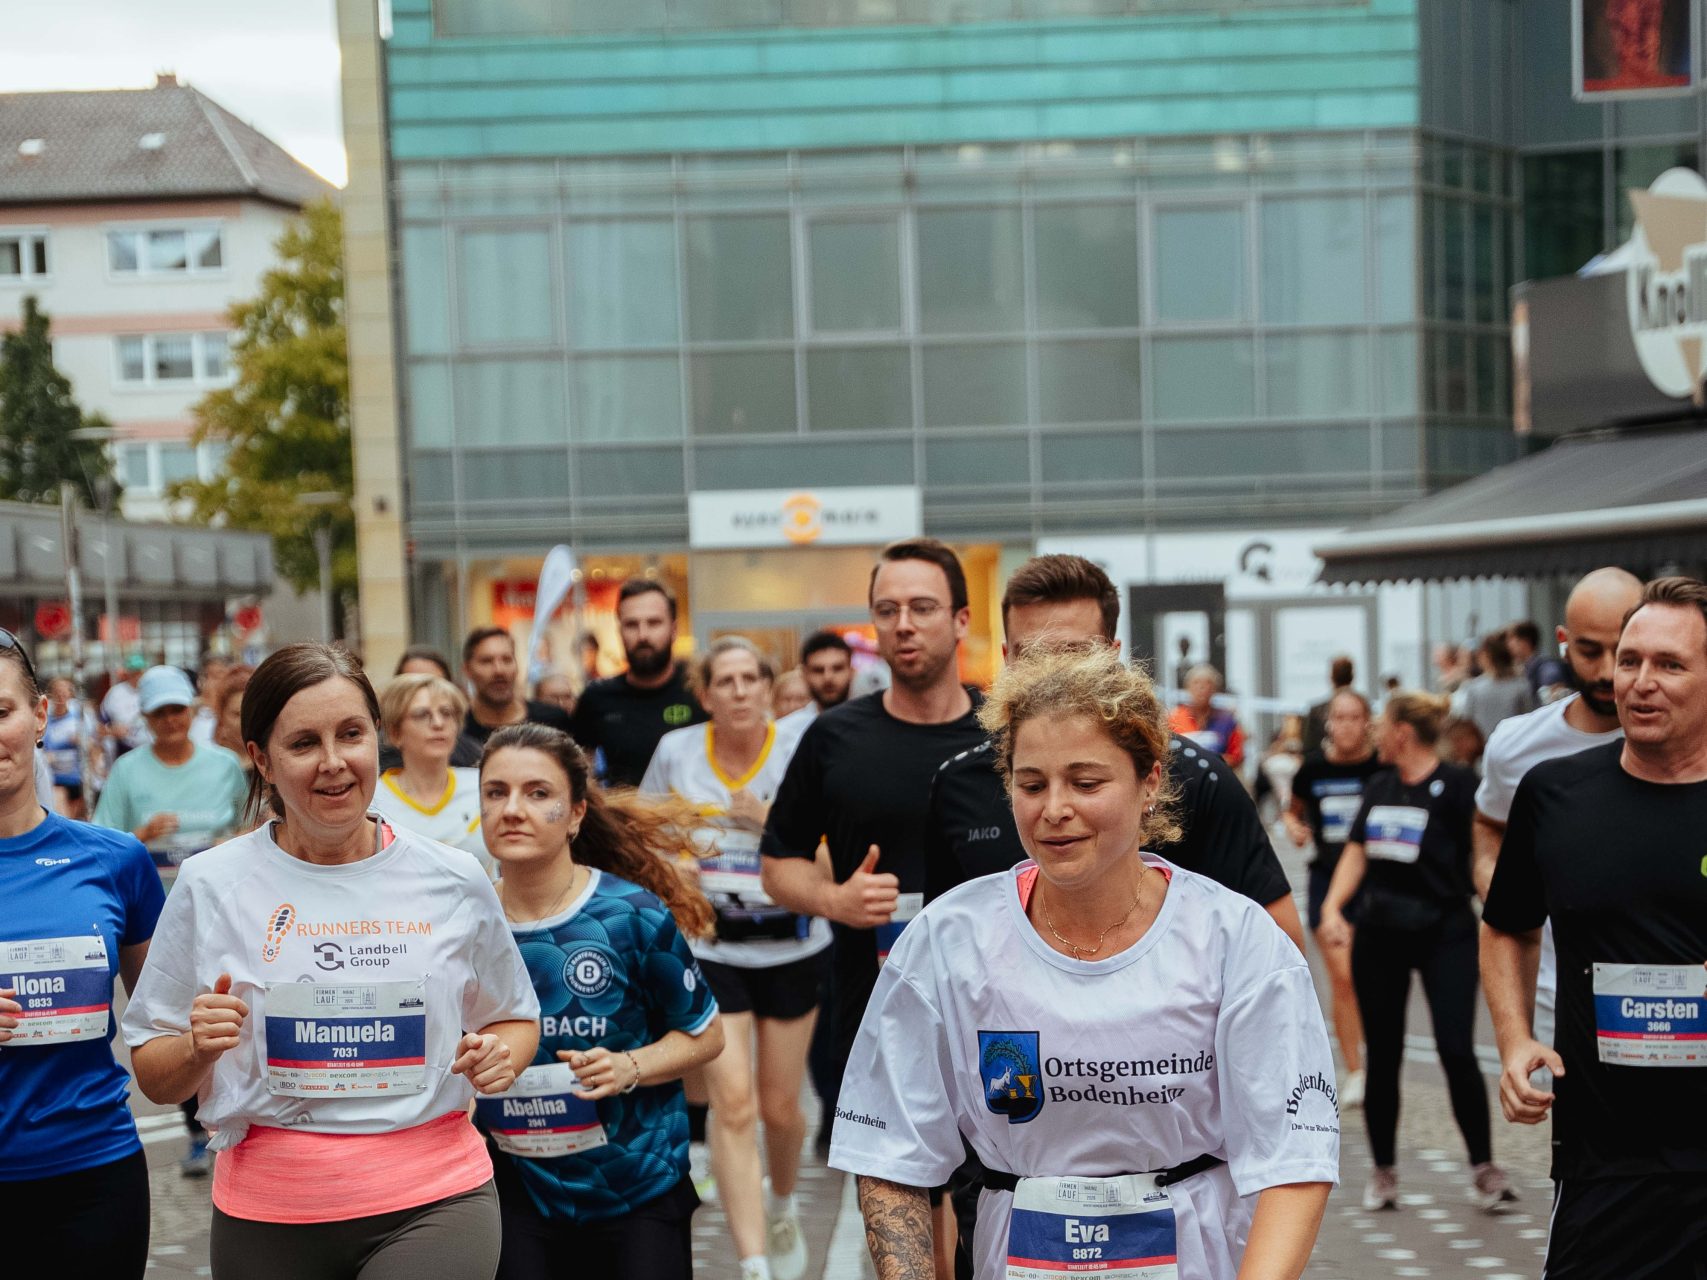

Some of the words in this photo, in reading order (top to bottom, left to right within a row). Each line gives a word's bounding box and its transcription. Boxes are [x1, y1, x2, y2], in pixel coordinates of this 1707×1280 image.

[968, 826, 1001, 841] JAKO
[296, 921, 382, 937] RUNNERS
[384, 920, 432, 936] TEAM
[349, 944, 407, 956] Landbell
[350, 957, 390, 968] Group
[583, 965, 595, 979] B
[12, 974, 66, 996] Ilona
[28, 997, 53, 1009] 8833
[315, 995, 336, 1004] LAUF
[1621, 997, 1699, 1019] Carsten
[295, 1020, 395, 1043] Manuela
[332, 1047, 358, 1058] 7031
[1044, 1050, 1213, 1083] Ortsgemeinde
[502, 1098, 567, 1118] Abelina
[1058, 1189, 1077, 1199] LAUF
[1065, 1218, 1110, 1243] Eva
[1072, 1248, 1102, 1260] 8872
